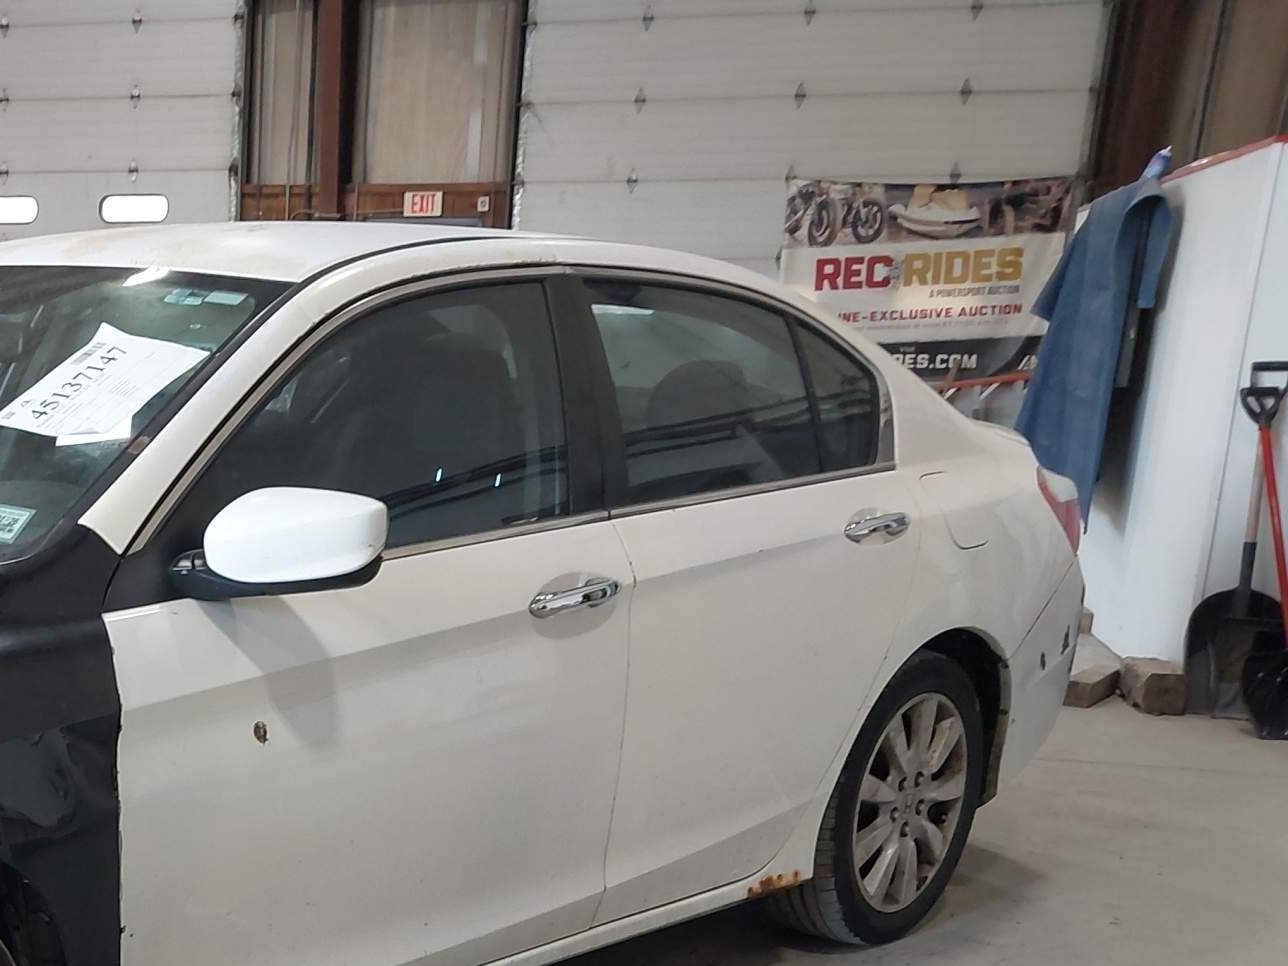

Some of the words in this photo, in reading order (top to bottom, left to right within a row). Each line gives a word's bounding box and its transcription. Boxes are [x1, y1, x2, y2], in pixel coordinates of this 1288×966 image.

[411, 193, 437, 214] EXIT
[814, 255, 894, 292] REC
[902, 247, 1025, 288] RIDES
[838, 307, 953, 323] NE-EXCLUSIVE
[958, 303, 1023, 318] AUCTION
[31, 346, 127, 419] 45137147
